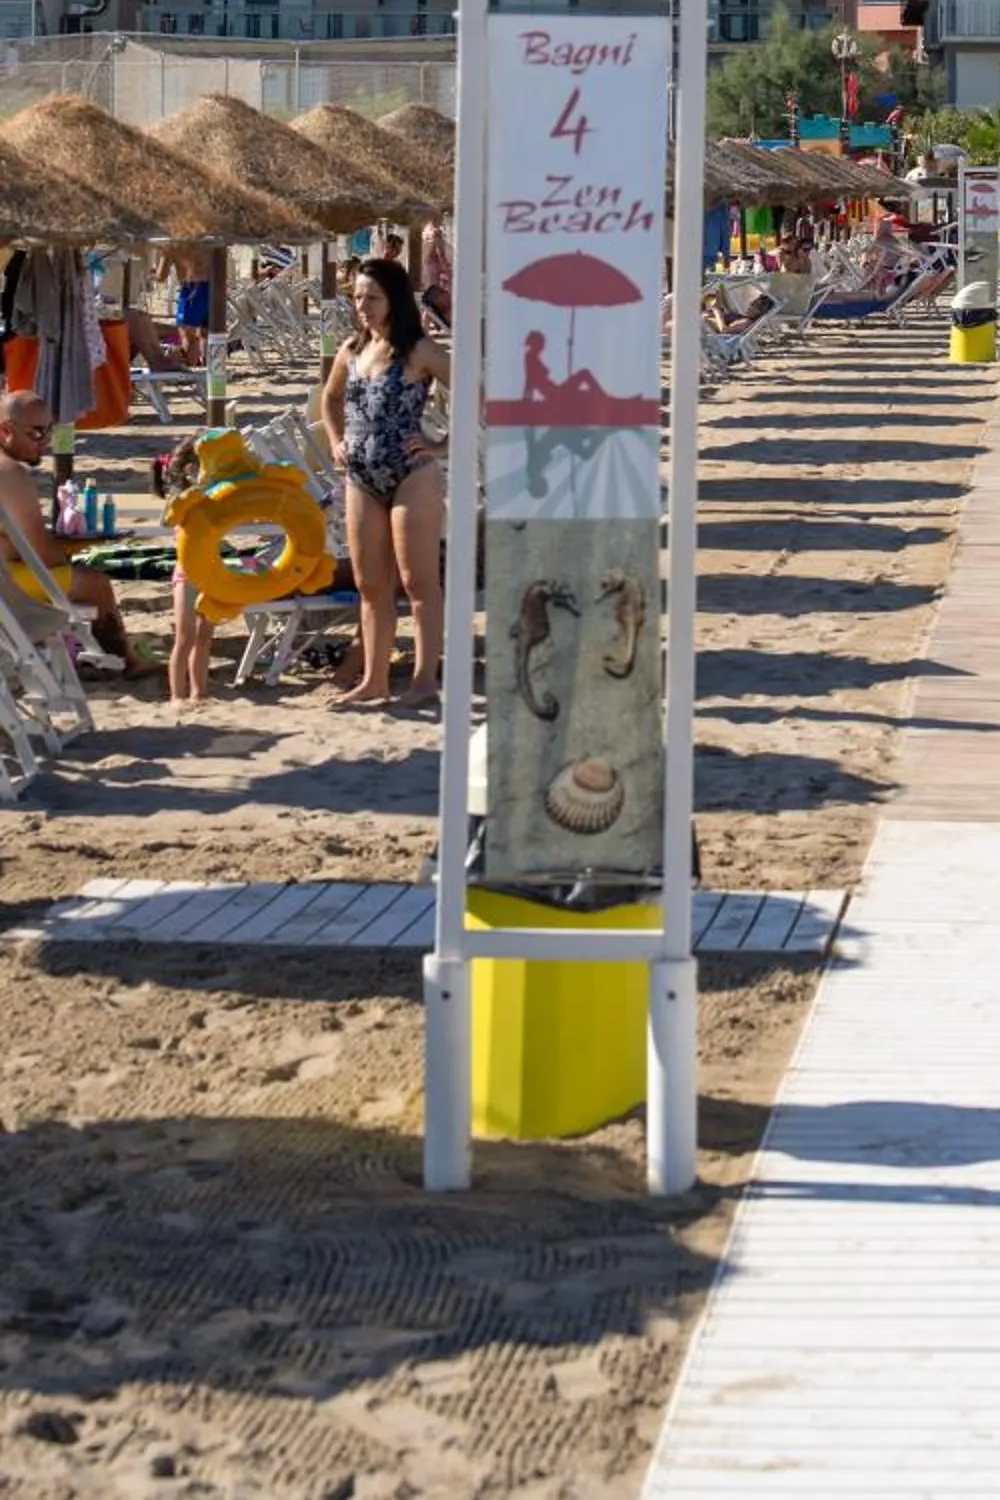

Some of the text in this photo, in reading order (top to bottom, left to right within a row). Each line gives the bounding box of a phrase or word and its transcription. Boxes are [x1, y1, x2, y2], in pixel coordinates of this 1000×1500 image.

[518, 30, 637, 75] Bagni
[550, 86, 597, 156] 4
[541, 174, 622, 208] Zen
[497, 199, 655, 234] Beach
